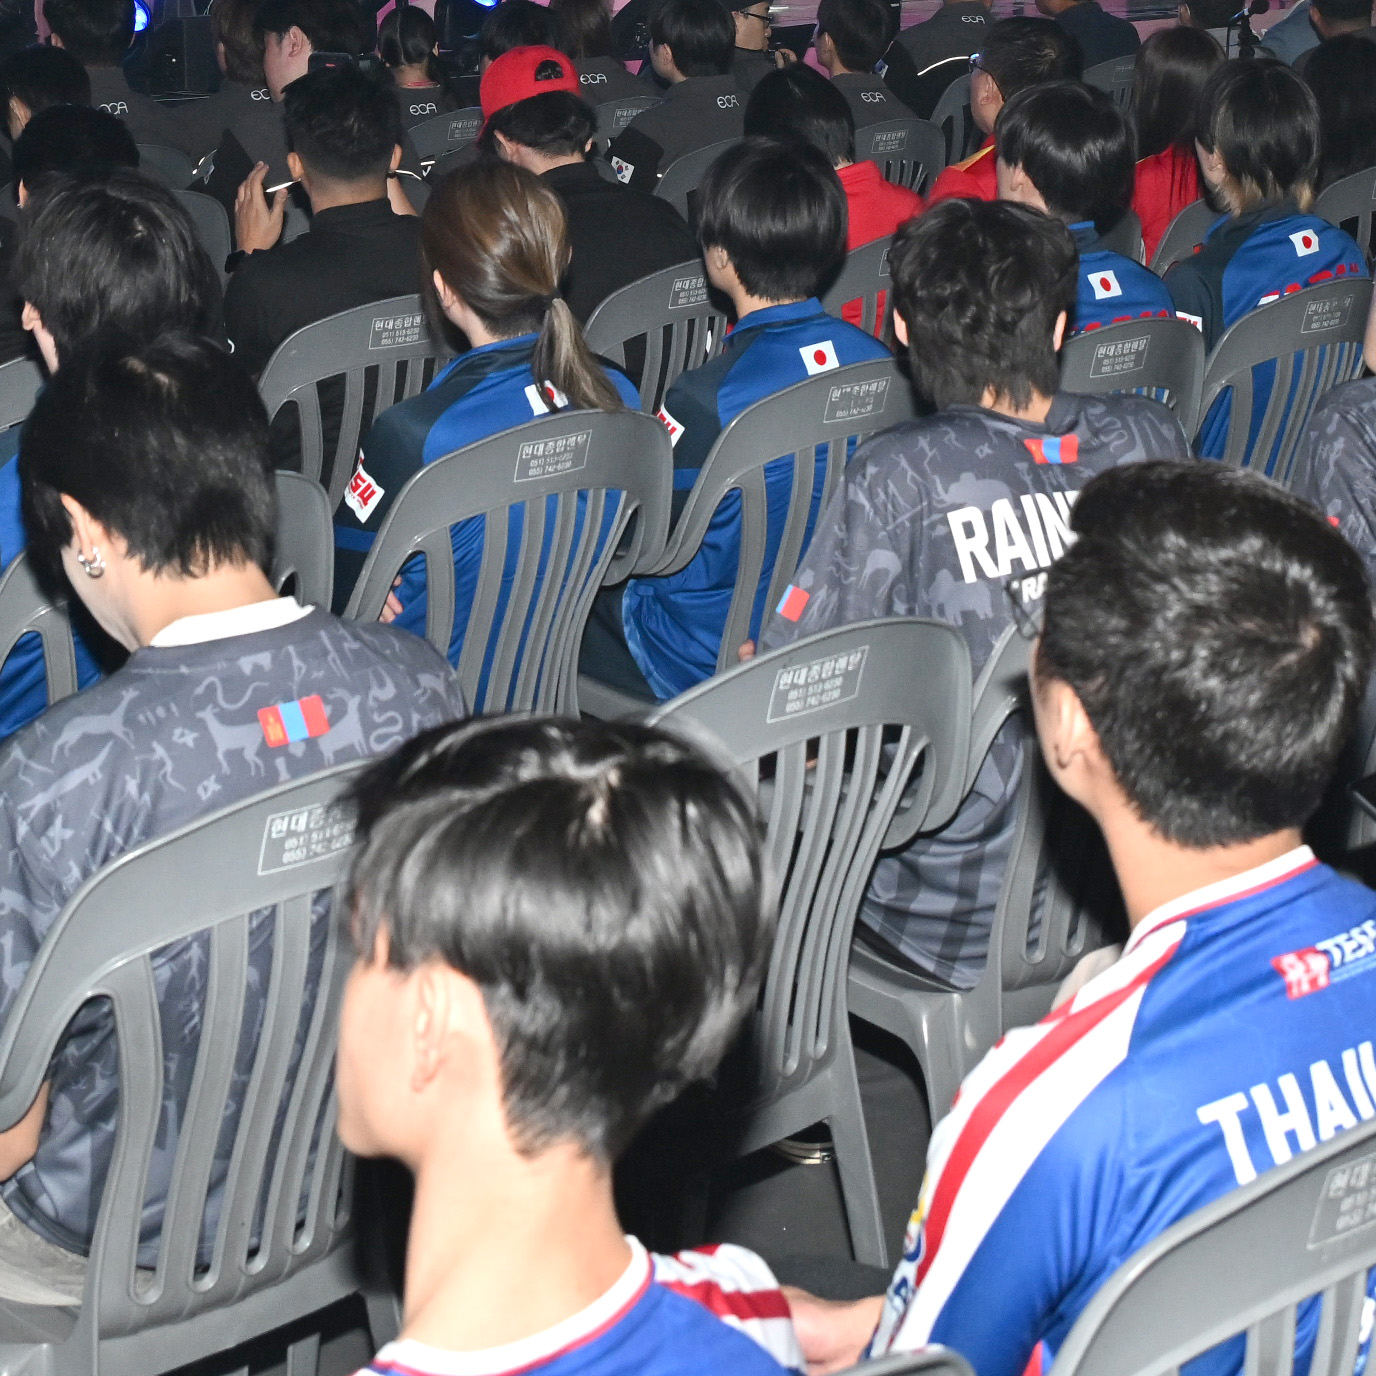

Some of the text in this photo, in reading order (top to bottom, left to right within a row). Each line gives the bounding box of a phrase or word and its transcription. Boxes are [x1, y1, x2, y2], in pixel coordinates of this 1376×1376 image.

[962, 15, 985, 25] ECA
[580, 73, 607, 85] ECA
[250, 88, 270, 101] EC
[861, 92, 886, 102] ECA
[717, 95, 739, 109] ECA
[410, 103, 437, 115] ECA
[675, 277, 706, 292] 현대종합
[375, 315, 423, 331] 현대종합렌
